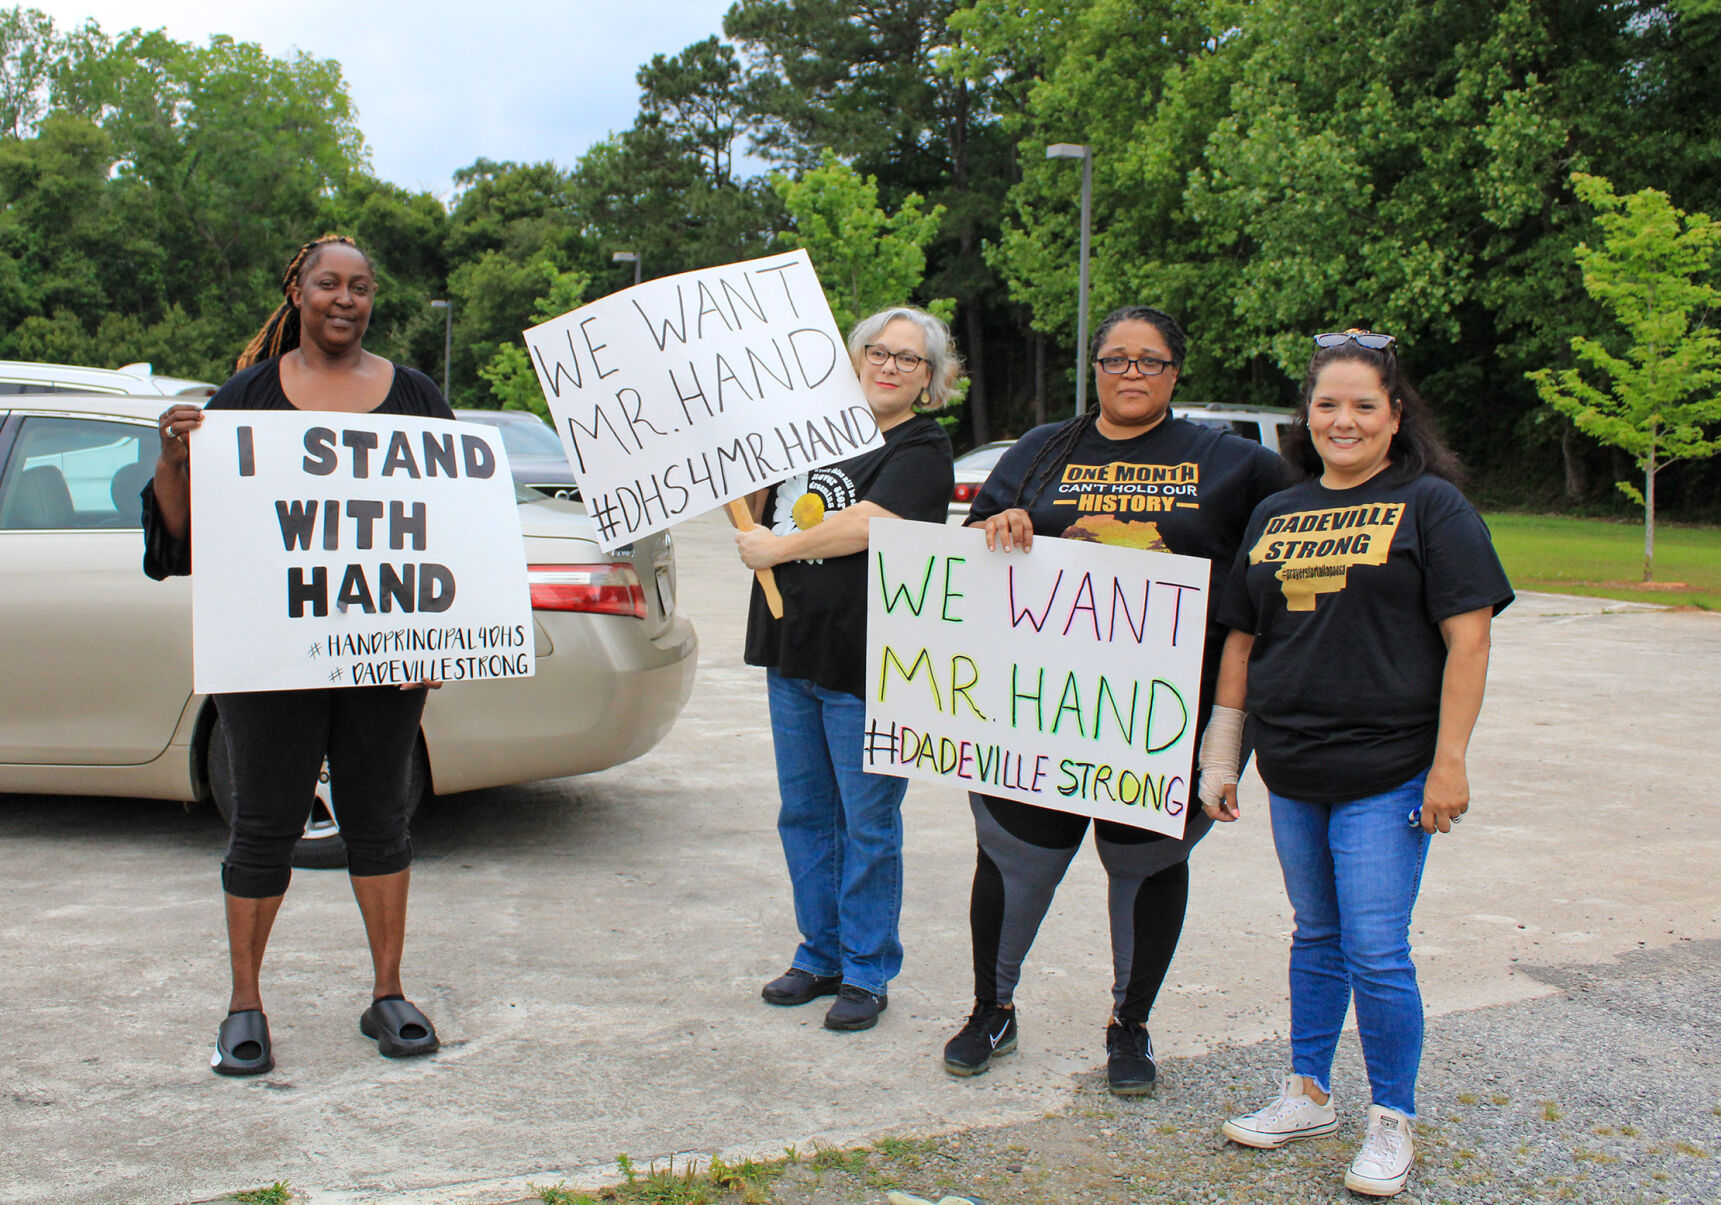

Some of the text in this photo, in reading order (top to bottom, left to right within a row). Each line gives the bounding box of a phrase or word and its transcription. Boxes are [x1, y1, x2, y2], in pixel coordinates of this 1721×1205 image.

[534, 261, 799, 397] WE WANT
[568, 328, 836, 474] MR. HAND
[237, 426, 496, 479] I STAND
[1066, 465, 1195, 482] ONE MONTH
[1058, 483, 1198, 496] CAN'T HOLD OUR
[1077, 494, 1176, 512] HISTORY
[274, 500, 427, 551] WITH
[1265, 534, 1371, 560] STRONG
[1266, 507, 1399, 535] DADEVILLE
[287, 563, 456, 618] HAND
[878, 551, 1201, 647] WE WANT
[880, 645, 1188, 754] MR. HAND
[864, 718, 1184, 816] #DADEVILLE STRONG
